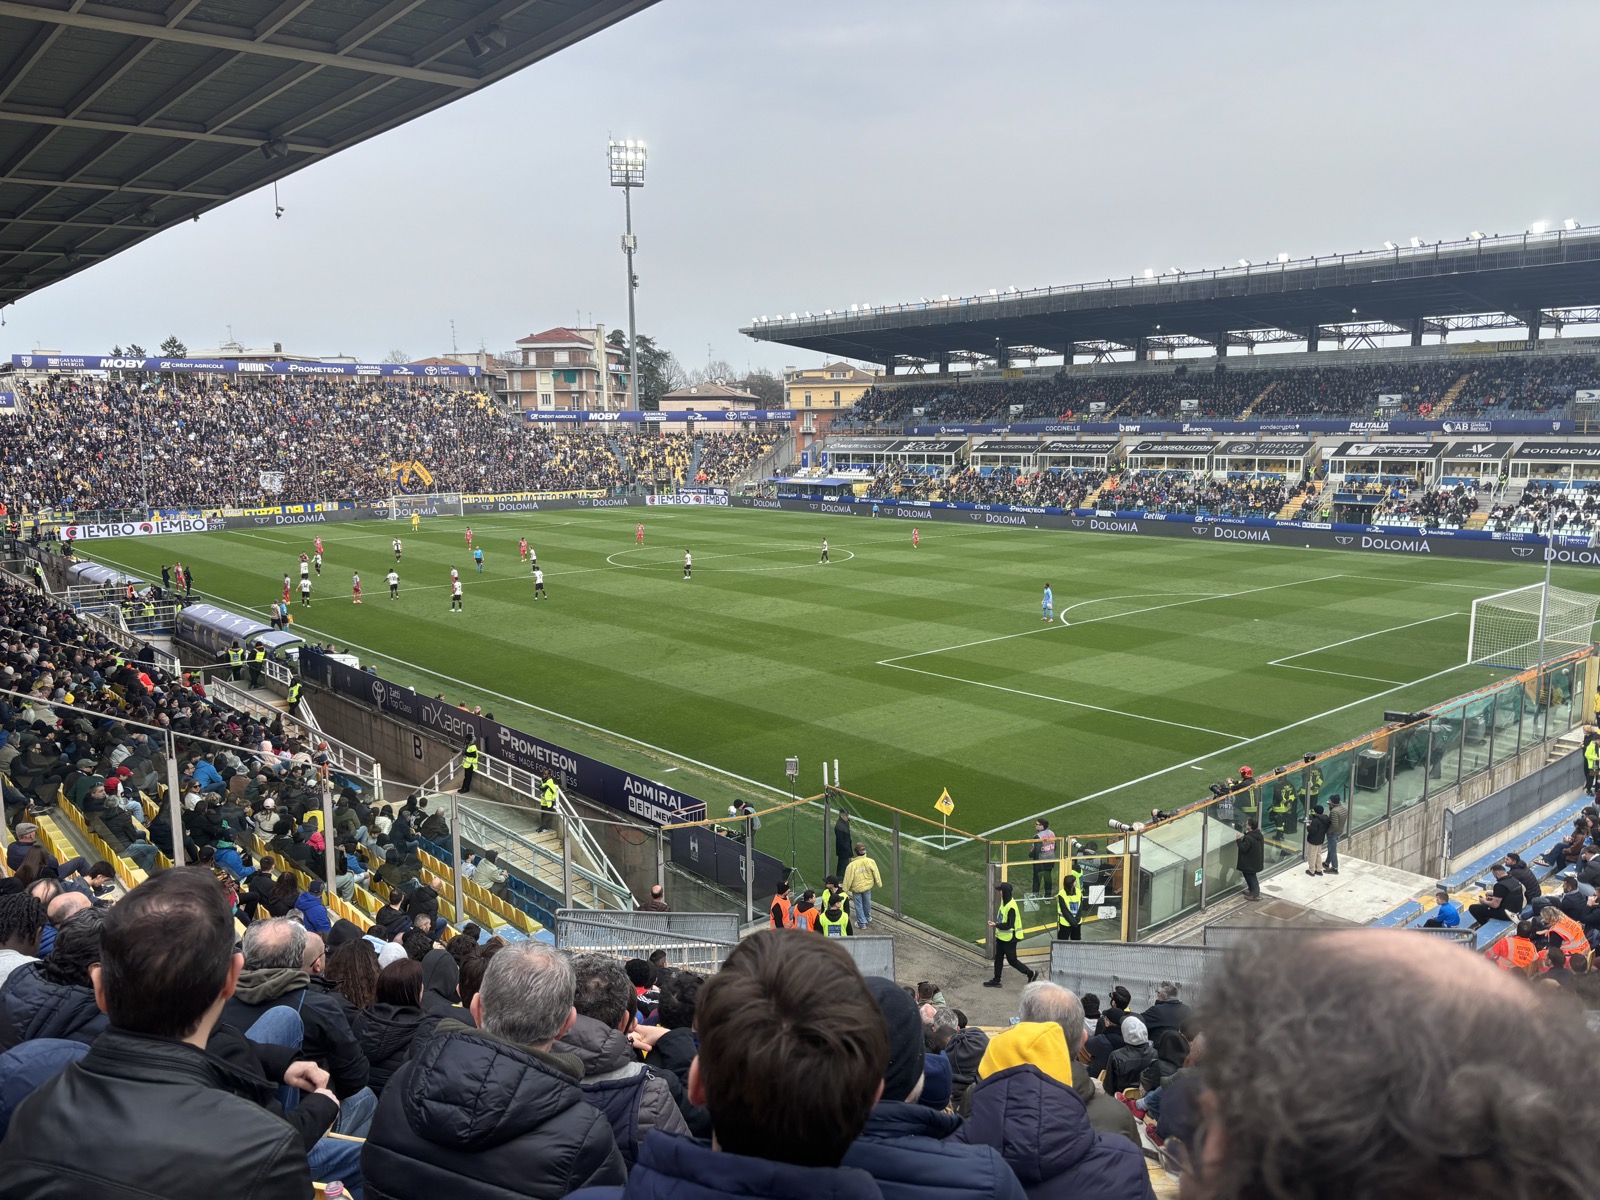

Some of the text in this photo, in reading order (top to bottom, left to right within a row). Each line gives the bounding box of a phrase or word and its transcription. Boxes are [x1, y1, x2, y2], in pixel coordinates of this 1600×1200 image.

[100, 359, 146, 368] MOBY
[288, 364, 344, 373] PROMETEON
[499, 502, 539, 511] DOLOMIA
[593, 498, 628, 506] DOLOMIA
[754, 499, 781, 508] DOLOMIA
[395, 507, 438, 517] DOLOMIA
[822, 503, 851, 513] DOLOMIA
[898, 508, 932, 518] DOLOMIA
[276, 513, 325, 524] DOLOMIA
[986, 514, 1026, 525] DOLOMIA
[1090, 519, 1138, 532] DOLOMIA
[1214, 527, 1270, 541] DOLOMIA
[1362, 536, 1430, 552] DOLOMIA
[389, 687, 400, 698] Zatti
[390, 697, 412, 714] Top Class
[413, 734, 423, 760] B
[498, 726, 577, 774] PROMETEON
[518, 756, 534, 770] MADE
